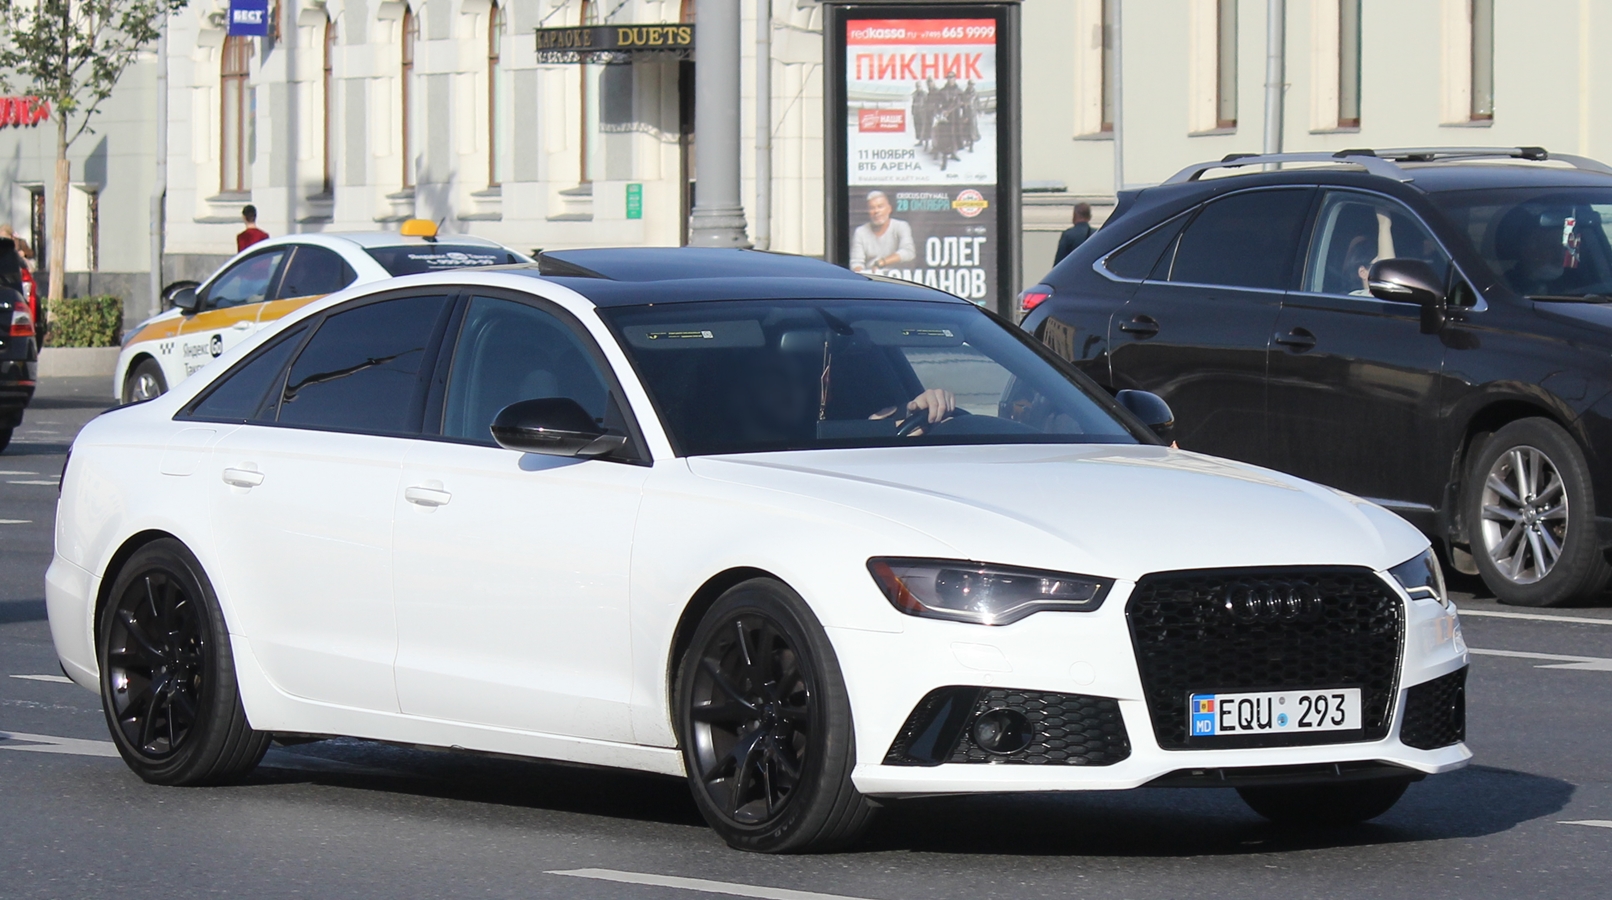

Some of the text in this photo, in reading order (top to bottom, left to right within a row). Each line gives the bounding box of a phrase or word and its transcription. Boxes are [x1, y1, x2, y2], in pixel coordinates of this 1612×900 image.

[537, 29, 592, 48] КАРАОКЕ
[617, 26, 691, 46] DUETS
[942, 27, 964, 38] 665
[966, 26, 996, 38] 9999
[855, 52, 983, 80] ПИКНИК
[858, 149, 915, 160] 11 НОЯБРЯ
[858, 162, 922, 171] ВТБ АРЕНА
[925, 236, 987, 266] ОЛЕГ
[183, 343, 209, 358] Яндекс
[1219, 694, 1346, 731] EQU 293
[1196, 720, 1212, 733] MD
